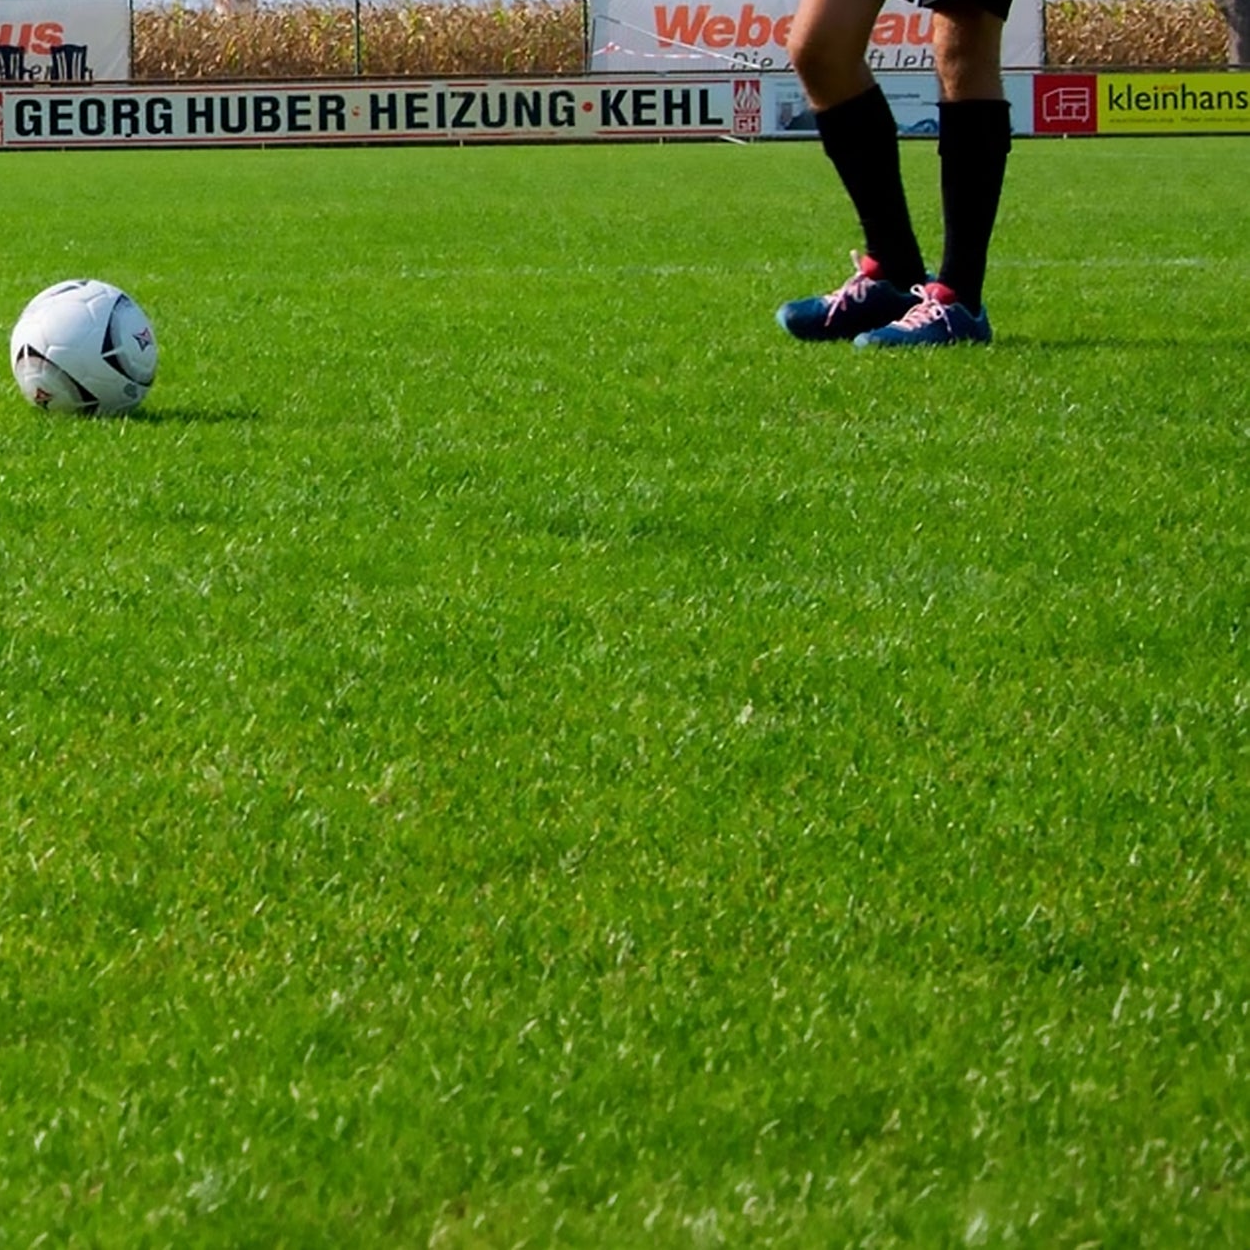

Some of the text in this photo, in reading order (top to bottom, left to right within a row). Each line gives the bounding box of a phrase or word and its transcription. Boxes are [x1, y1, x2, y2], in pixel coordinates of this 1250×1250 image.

[654, 4, 934, 48] Webeau
[15, 89, 724, 137] GEORG HUBER HEIZUNG KEHL
[1108, 83, 1249, 111] kleinhans
[735, 116, 760, 132] GH
